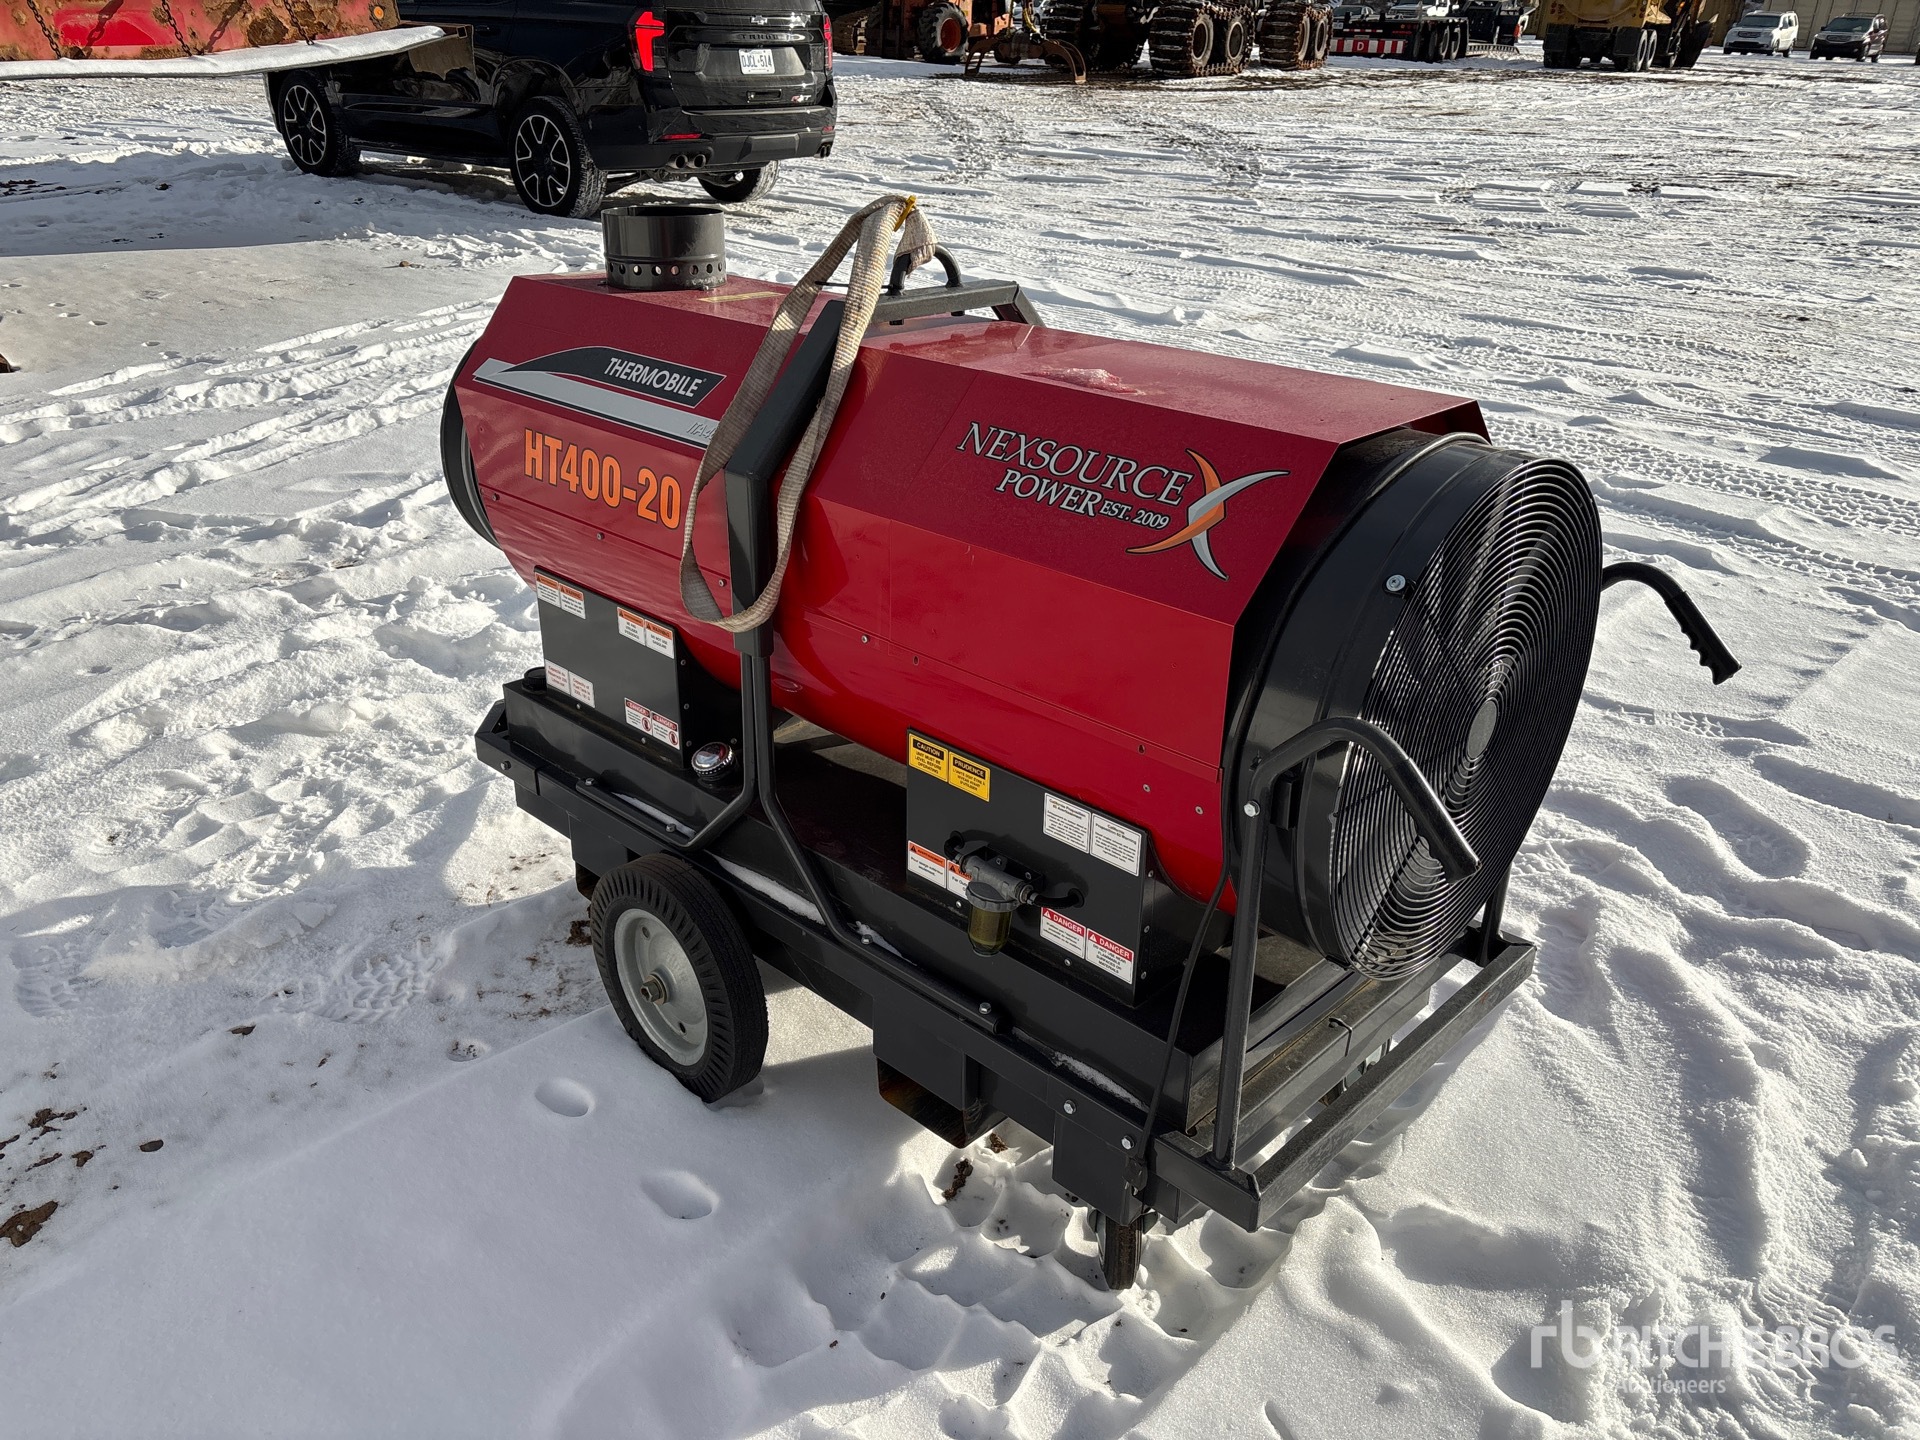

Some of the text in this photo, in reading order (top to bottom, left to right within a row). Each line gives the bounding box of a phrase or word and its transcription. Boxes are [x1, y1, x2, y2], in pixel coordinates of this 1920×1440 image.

[1357, 41, 1365, 51] D
[603, 357, 703, 398] THERMOBILE
[956, 421, 1195, 507] NEXSOURCE
[524, 428, 682, 530] HT400-20
[995, 468, 1171, 531] POWER EST. 2009
[917, 742, 940, 757] CAUTION
[954, 759, 984, 777] PRUDENCE
[1053, 914, 1082, 934] DANGER
[1099, 937, 1130, 959] DANGER
